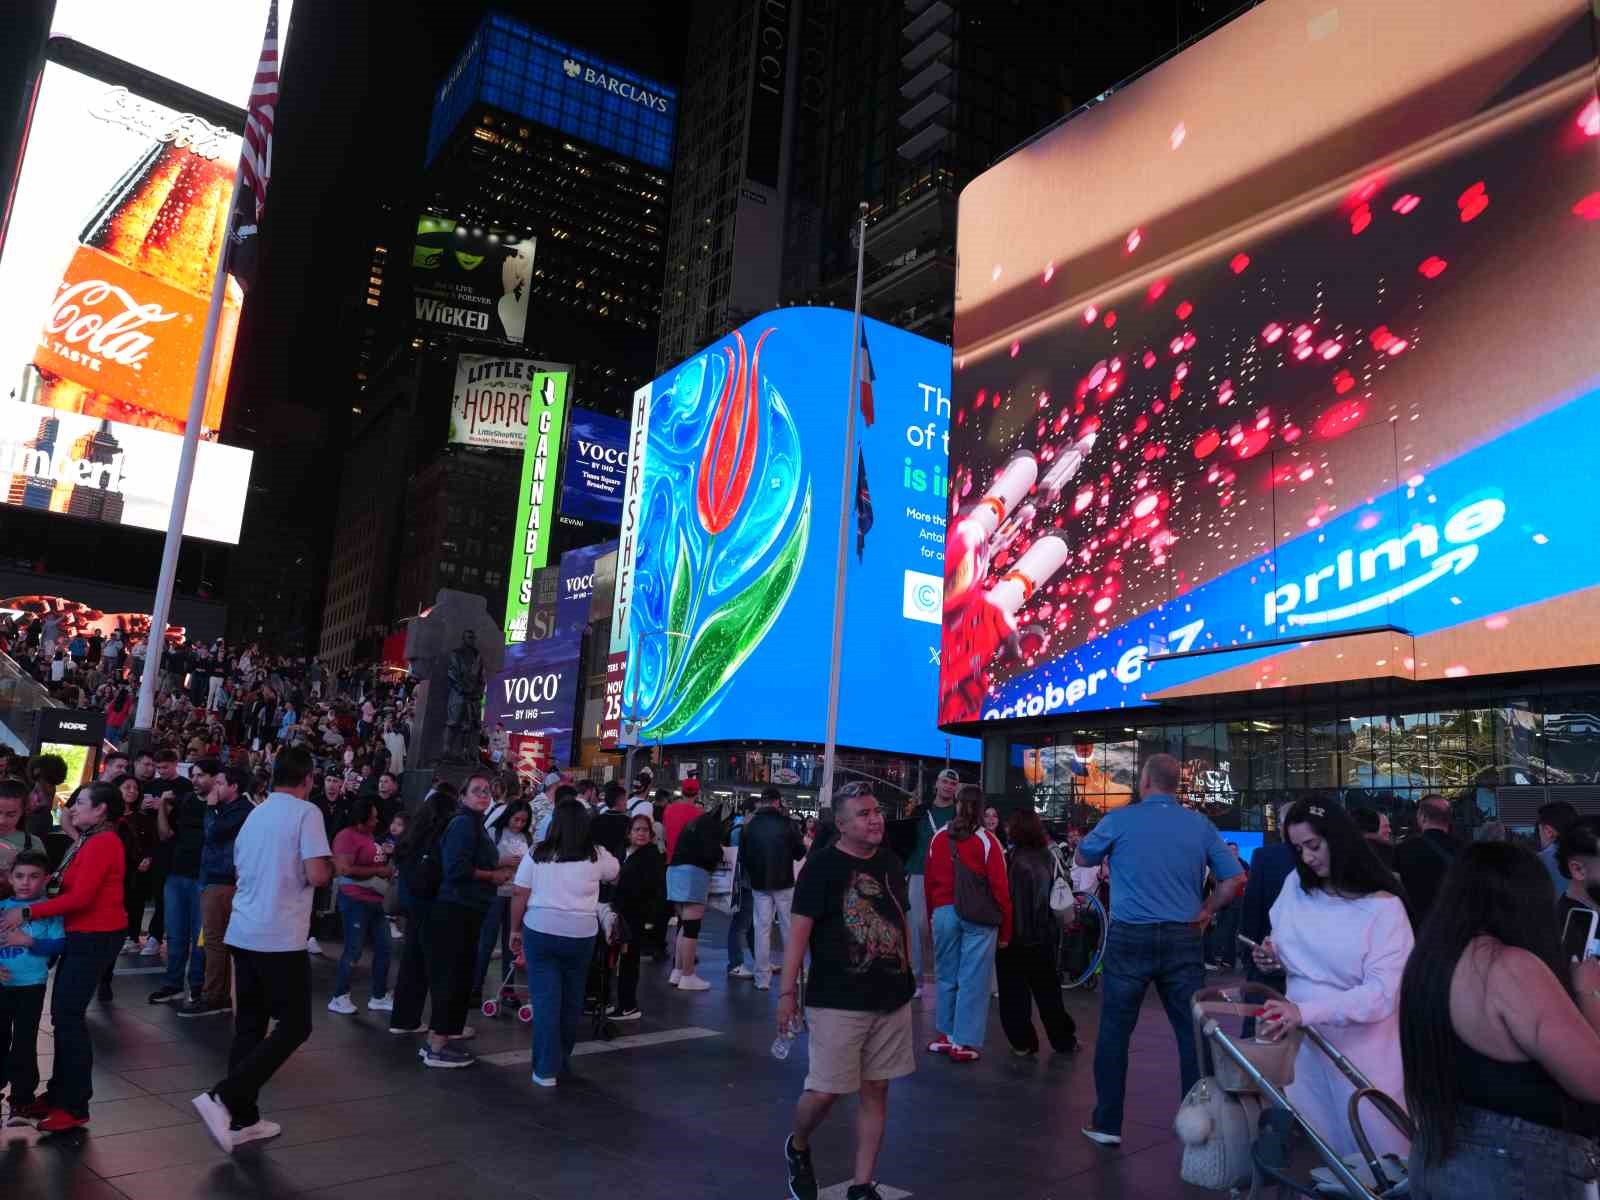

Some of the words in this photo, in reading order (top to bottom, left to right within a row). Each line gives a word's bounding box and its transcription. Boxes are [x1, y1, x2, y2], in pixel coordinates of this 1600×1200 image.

[583, 67, 667, 112] BARCLAYS
[53, 341, 102, 371] TASTE
[468, 361, 524, 384] LITTLE
[906, 422, 936, 450] of
[903, 456, 927, 492] is
[519, 411, 552, 604] CANNABIS
[616, 396, 647, 640] HERSHEY
[906, 507, 931, 524] More
[921, 546, 935, 559] for
[1264, 497, 1506, 626] prime
[607, 680, 624, 695] NOV
[515, 709, 524, 720] BY
[525, 707, 538, 719] IHG
[605, 695, 622, 721] 25
[59, 721, 88, 731] NOPE
